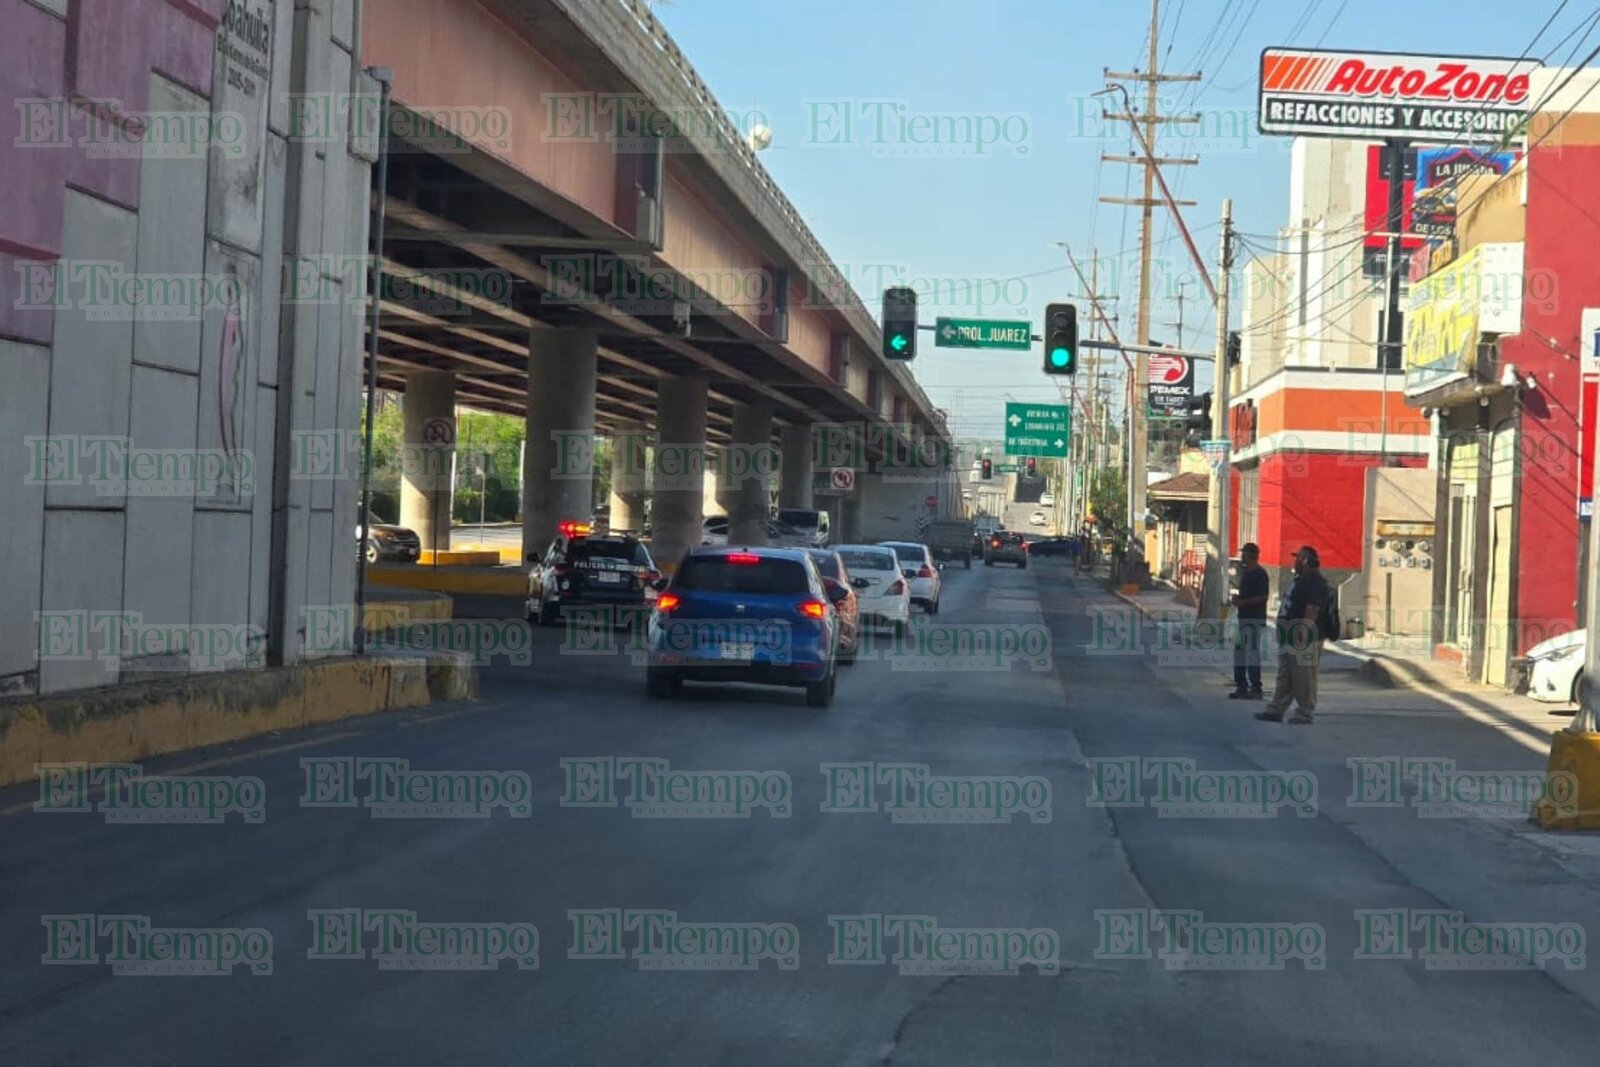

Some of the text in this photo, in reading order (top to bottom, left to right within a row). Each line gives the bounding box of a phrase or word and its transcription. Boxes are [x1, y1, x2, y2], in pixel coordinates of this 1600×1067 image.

[1327, 58, 1529, 103] AutoZone
[1270, 100, 1395, 127] REFACCIONES
[1401, 108, 1415, 127] Y
[1436, 163, 1451, 178] LA
[988, 327, 1027, 344] JUAREZ
[1150, 385, 1191, 395] PEMEX
